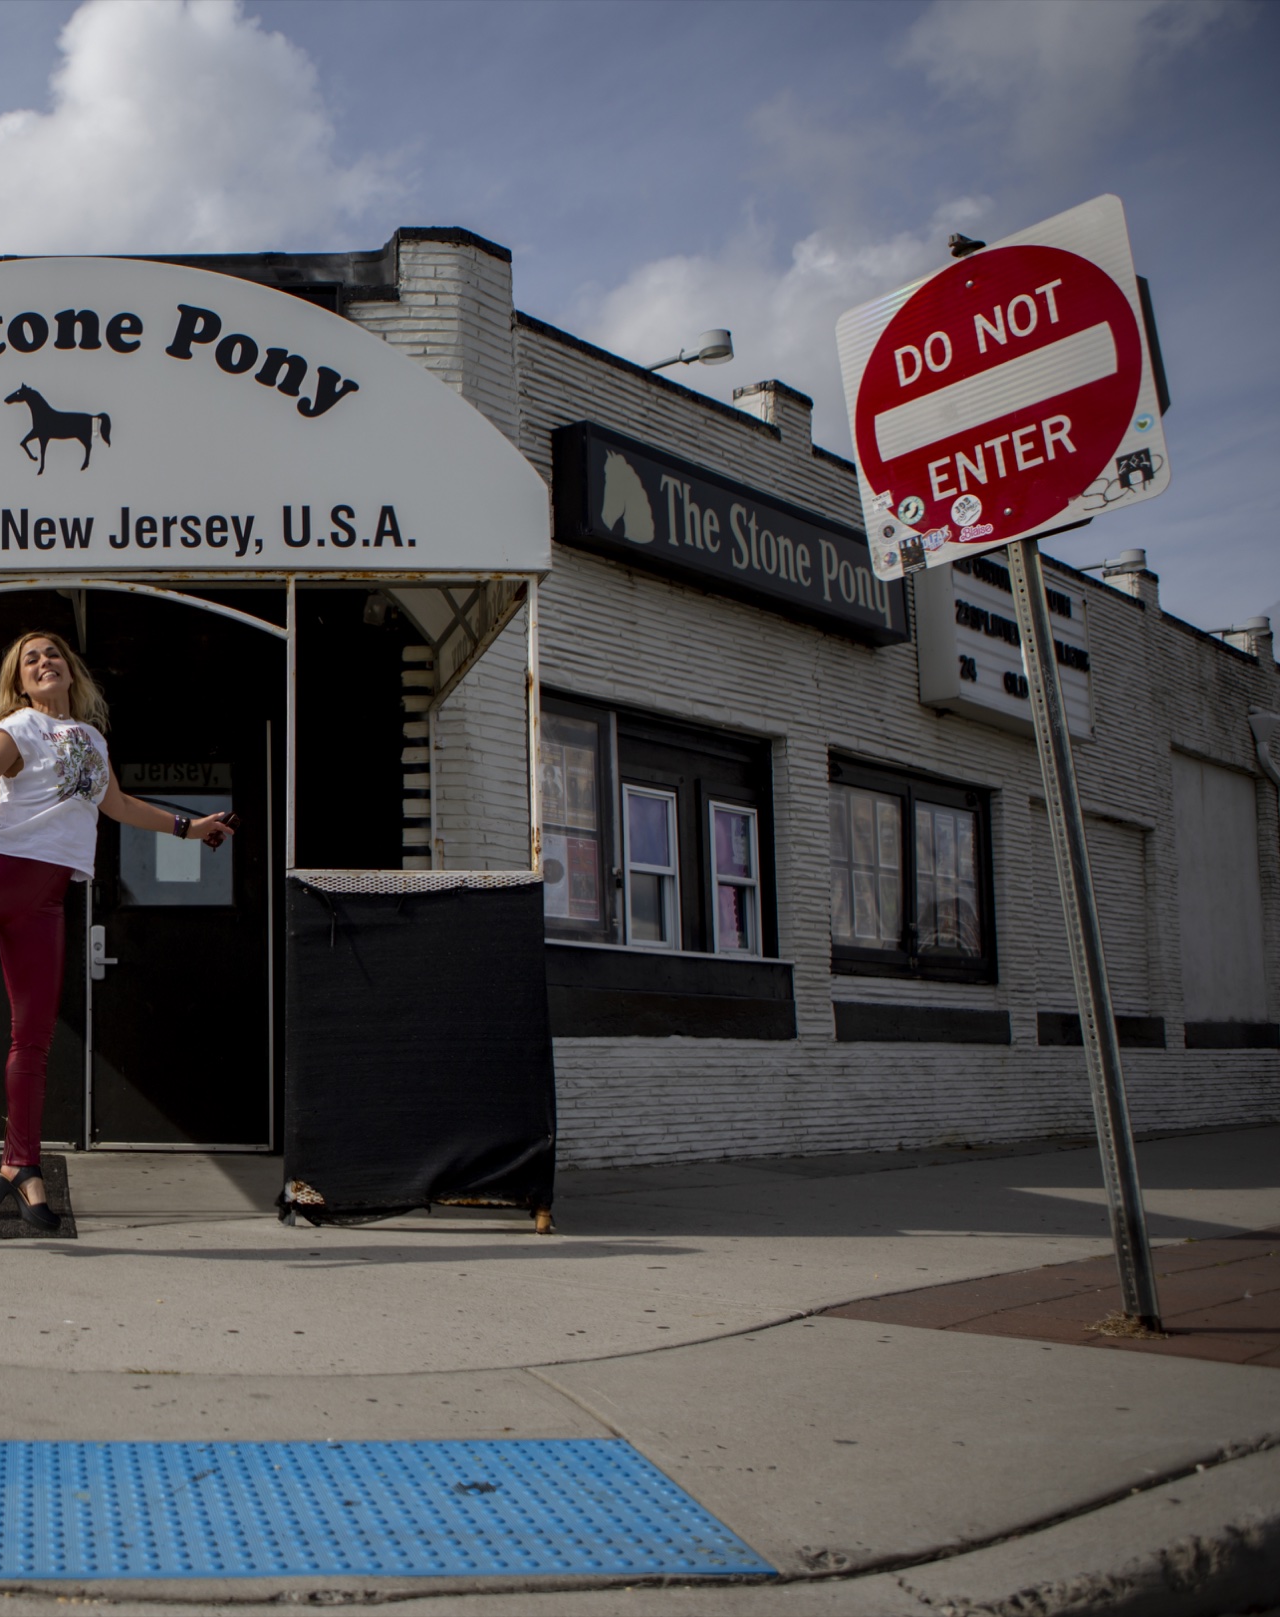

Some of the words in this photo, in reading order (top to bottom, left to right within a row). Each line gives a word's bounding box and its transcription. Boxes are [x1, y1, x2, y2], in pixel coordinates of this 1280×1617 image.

[165, 304, 360, 418] Pony
[893, 331, 953, 387] DO
[973, 278, 1062, 354] NOT
[927, 414, 1078, 502] ENTER
[1, 508, 95, 550] New
[109, 506, 263, 557] Jersey,
[283, 504, 417, 548] U.S.A.
[660, 474, 721, 553] The
[730, 502, 812, 588] Stone
[819, 538, 893, 630] Pony
[960, 655, 977, 683] 24
